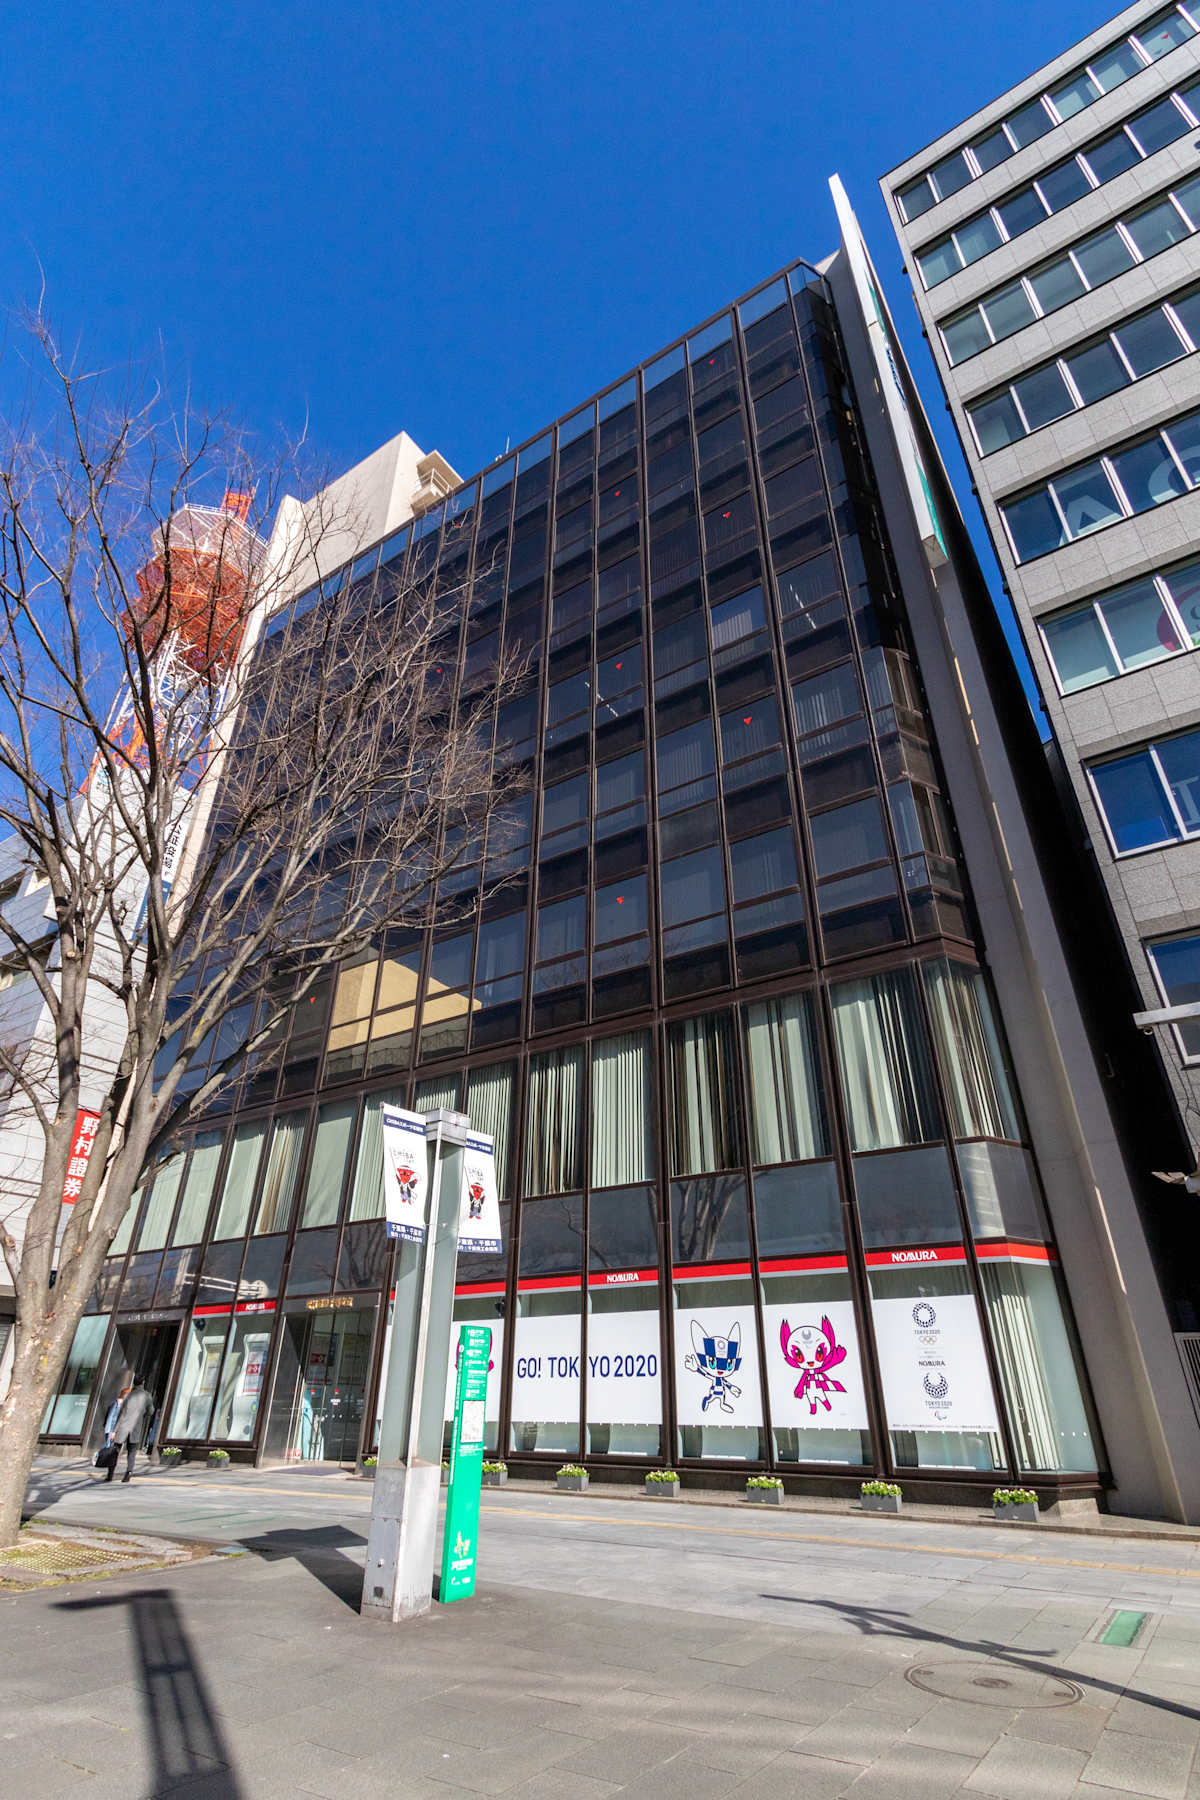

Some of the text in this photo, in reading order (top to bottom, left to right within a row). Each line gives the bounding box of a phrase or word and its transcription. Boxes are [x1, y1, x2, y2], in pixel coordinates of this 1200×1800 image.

[63, 1116, 100, 1198] 野村證券
[891, 1250, 938, 1262] NOMURA
[606, 1272, 640, 1283] NOMURA
[517, 1354, 657, 1379] GO! TOKYO 2020
